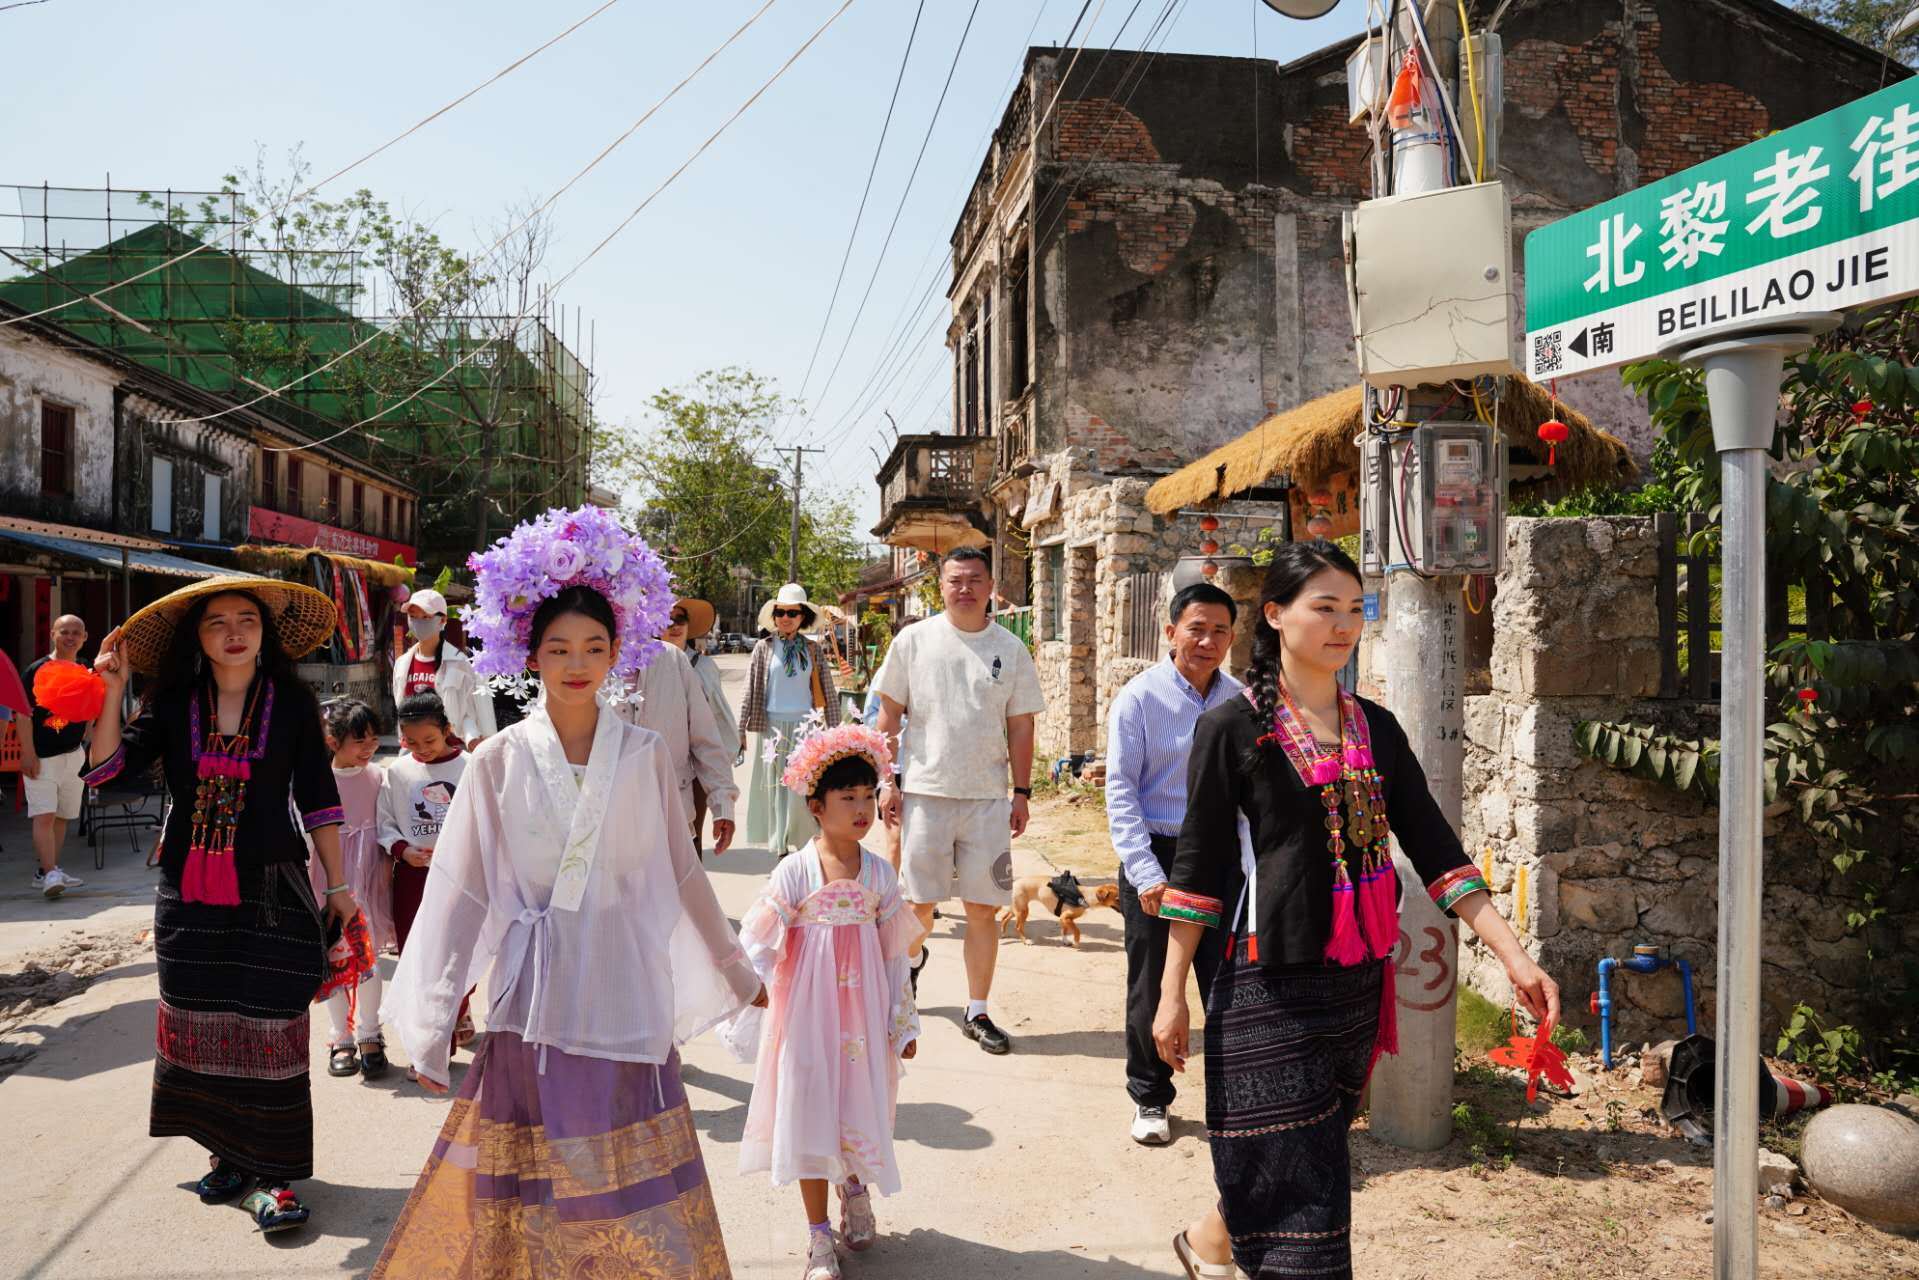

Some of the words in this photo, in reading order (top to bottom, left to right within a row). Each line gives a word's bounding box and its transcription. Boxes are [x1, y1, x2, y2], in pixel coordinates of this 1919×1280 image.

[1583, 103, 1919, 293] 北黎老街
[1658, 269, 1815, 337] BEILILAO
[1826, 246, 1889, 292] JIE
[1590, 321, 1615, 357] 南
